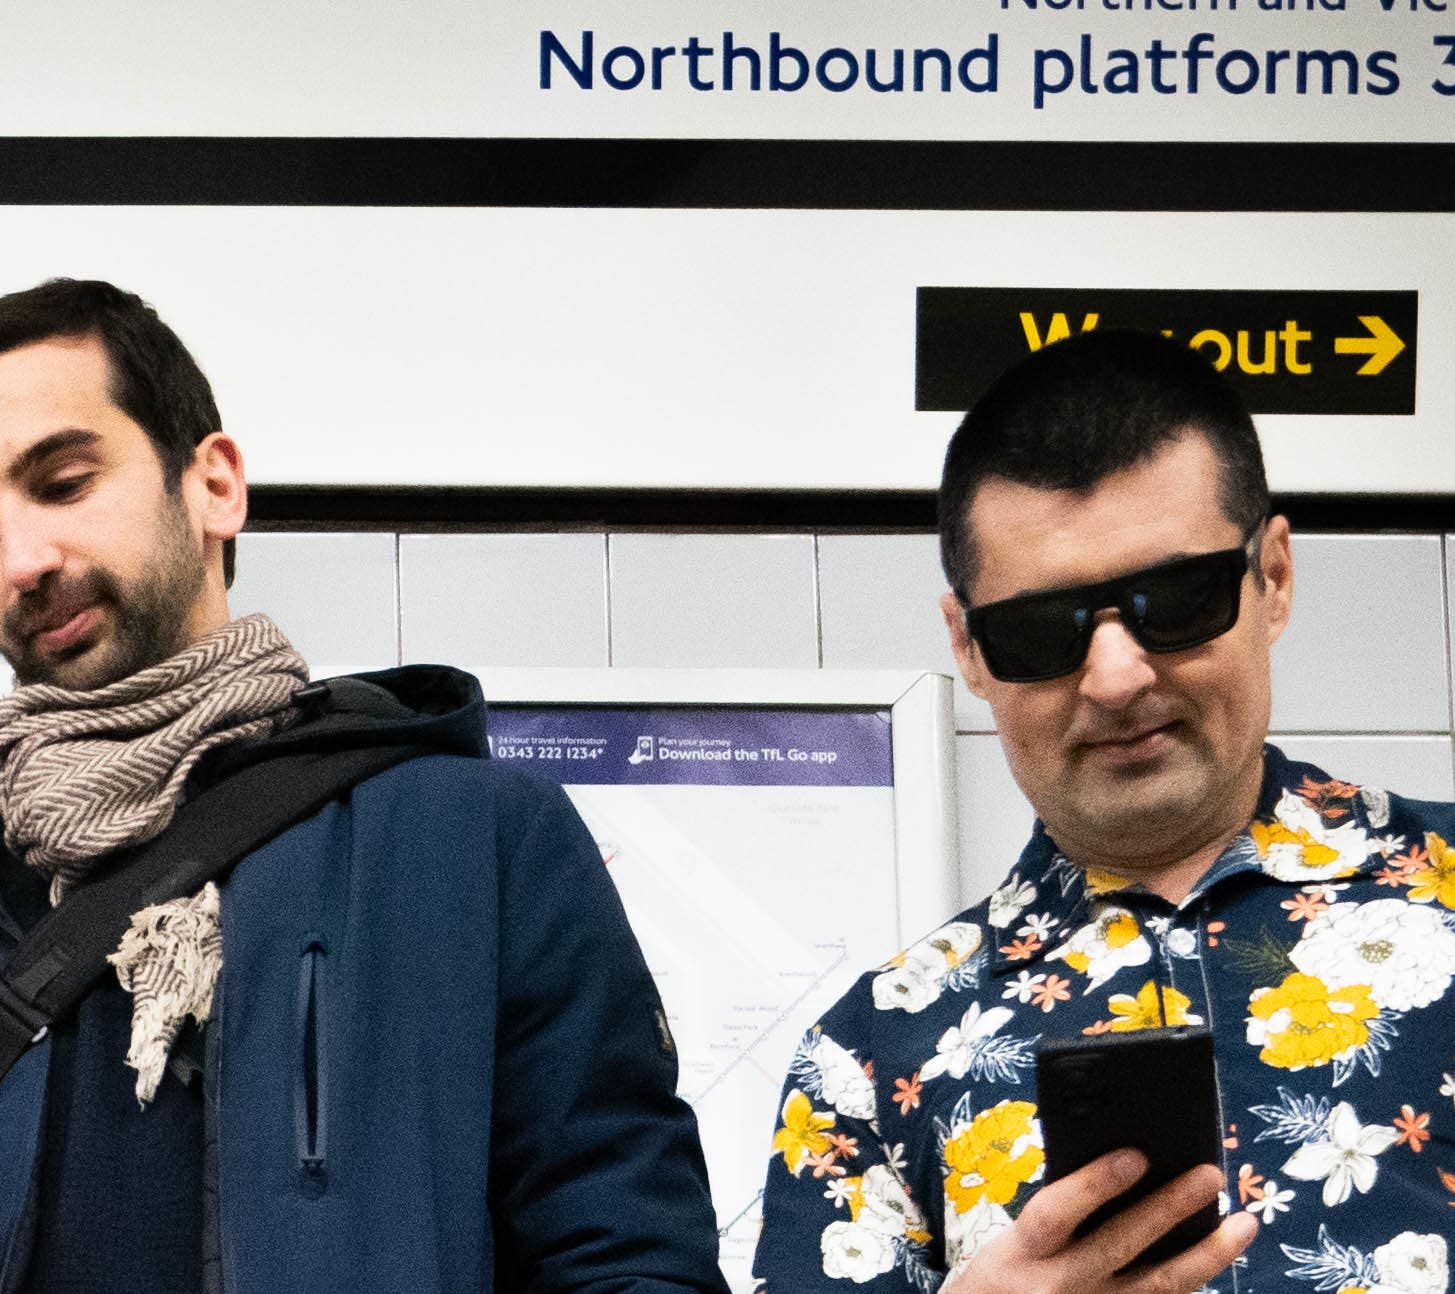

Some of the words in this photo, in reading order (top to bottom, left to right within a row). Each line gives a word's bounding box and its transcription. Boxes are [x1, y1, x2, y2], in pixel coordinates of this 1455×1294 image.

[539, 28, 999, 94] Northbound
[1032, 31, 1402, 111] platforms
[1188, 319, 1312, 376] out
[509, 736, 530, 745] hour
[531, 736, 556, 745] travel
[557, 736, 607, 745] information
[658, 737, 678, 746] Plan
[678, 739, 698, 748] your
[699, 737, 731, 748] journey
[497, 746, 534, 759] 0343
[537, 746, 562, 759] 222
[658, 747, 731, 761] Download
[734, 748, 758, 761] the
[760, 748, 785, 762] TfL
[787, 749, 808, 762] Go
[810, 751, 838, 764] app
